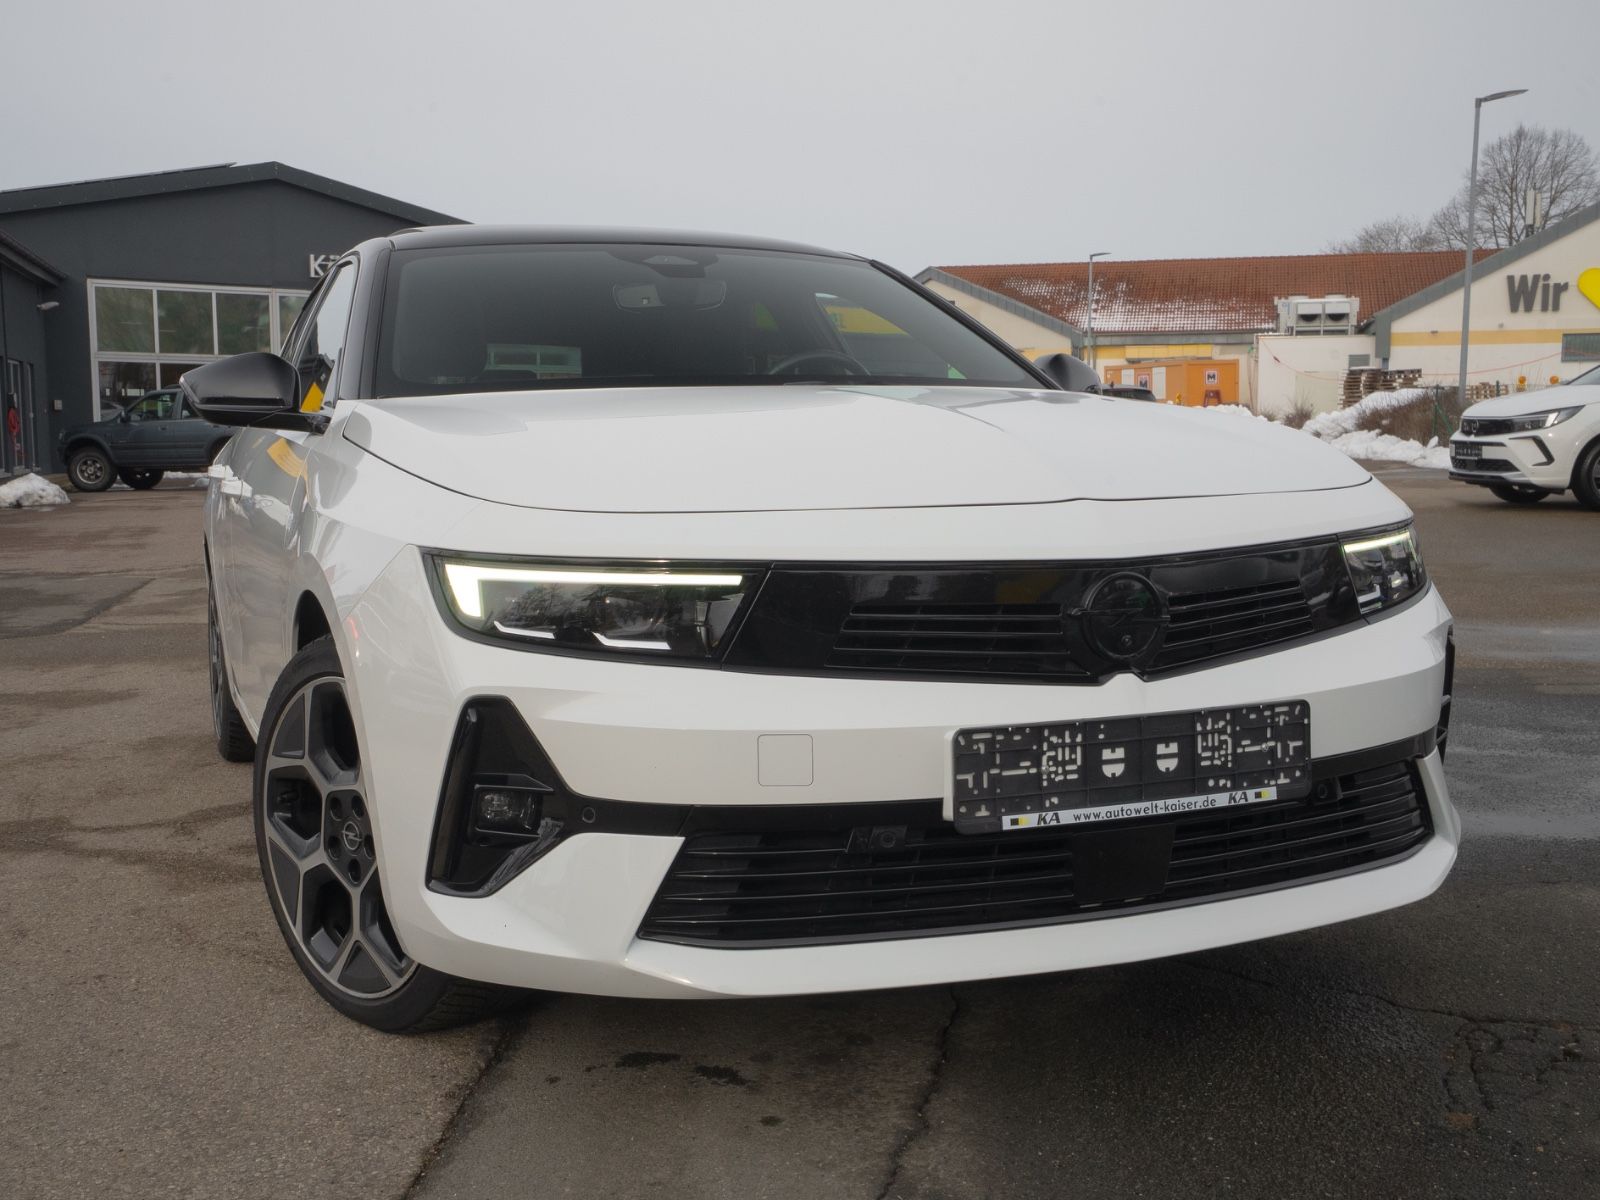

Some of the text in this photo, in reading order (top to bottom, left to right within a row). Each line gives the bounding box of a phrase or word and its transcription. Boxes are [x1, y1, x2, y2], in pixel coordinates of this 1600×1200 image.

[1506, 273, 1569, 314] Wir
[1036, 791, 1249, 825] KA www.autowelt-kaiser.de KA
